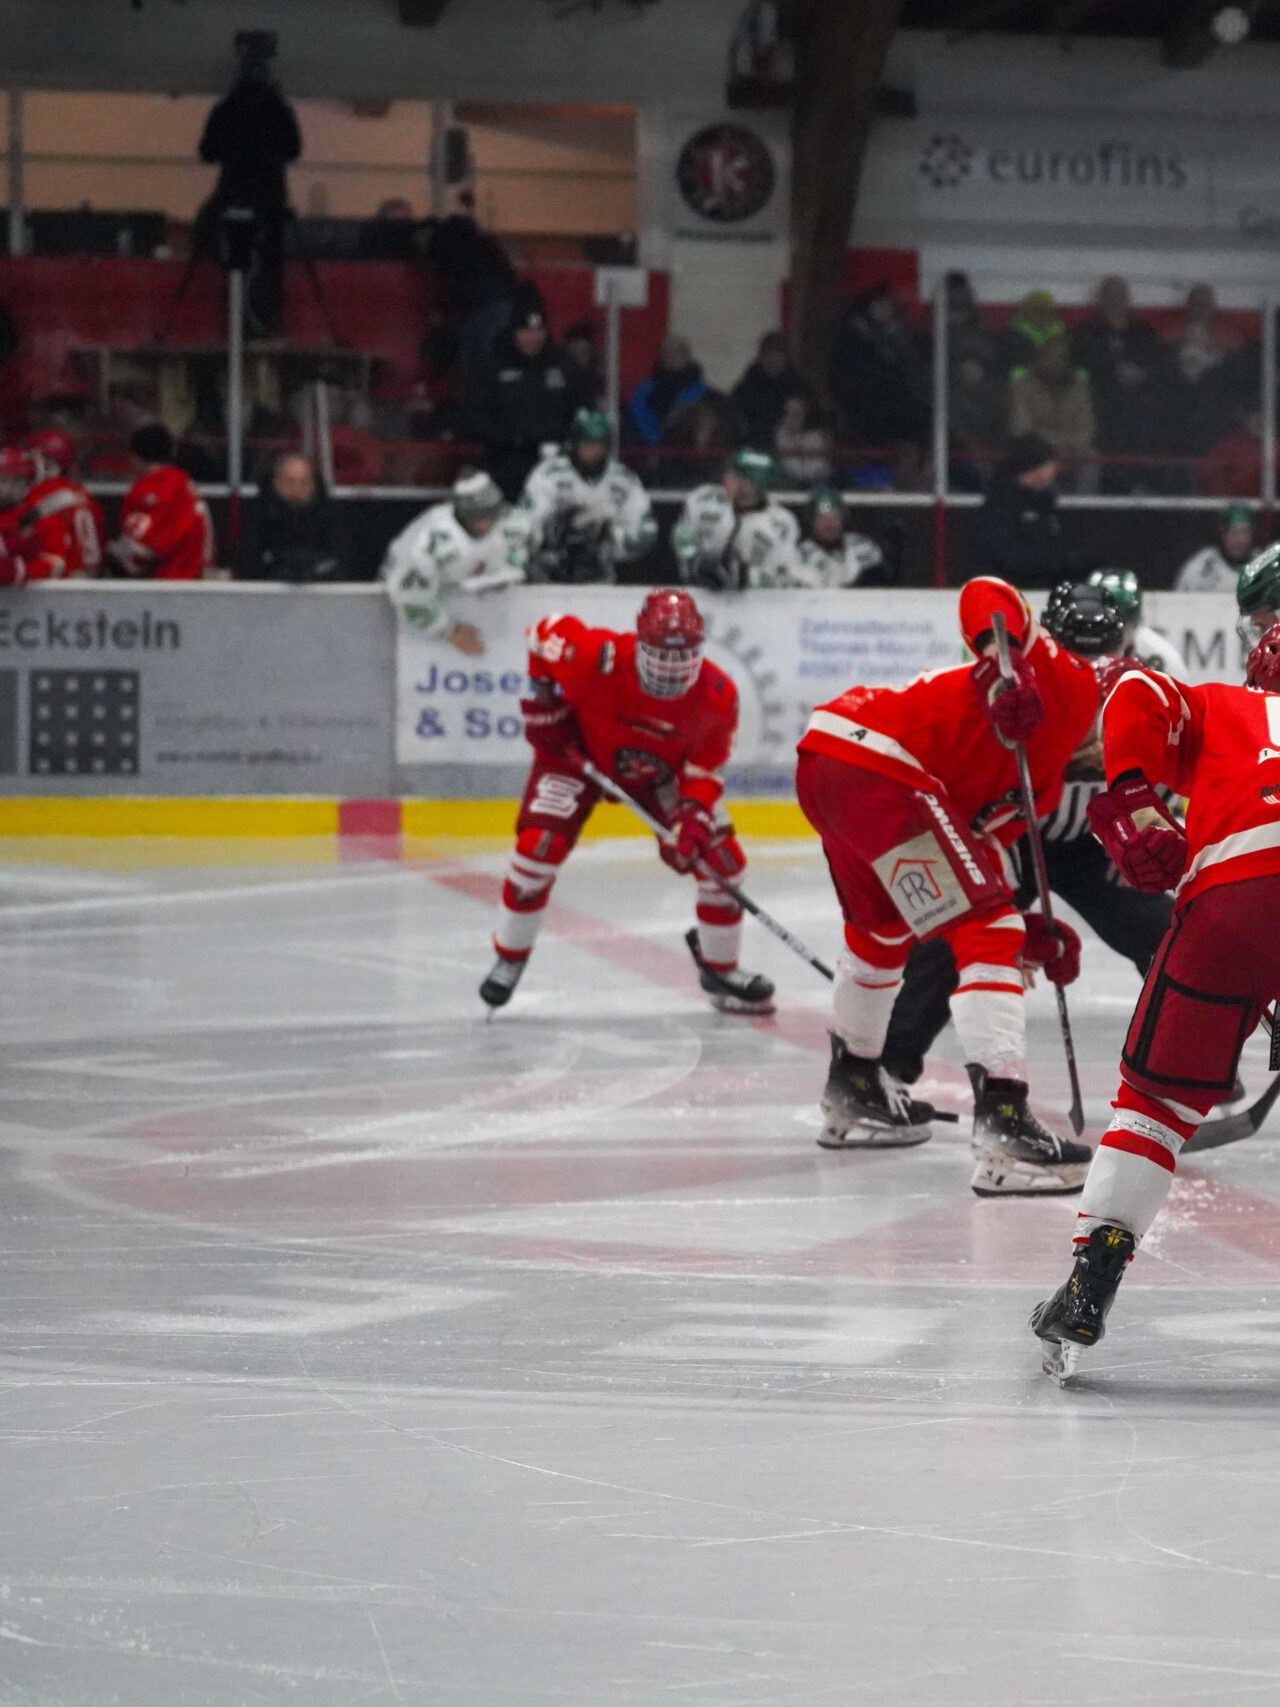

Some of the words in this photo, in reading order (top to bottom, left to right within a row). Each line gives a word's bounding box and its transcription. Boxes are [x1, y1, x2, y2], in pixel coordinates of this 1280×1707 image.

[985, 138, 1188, 190] eurofins
[415, 708, 445, 739] &
[464, 708, 526, 740] So
